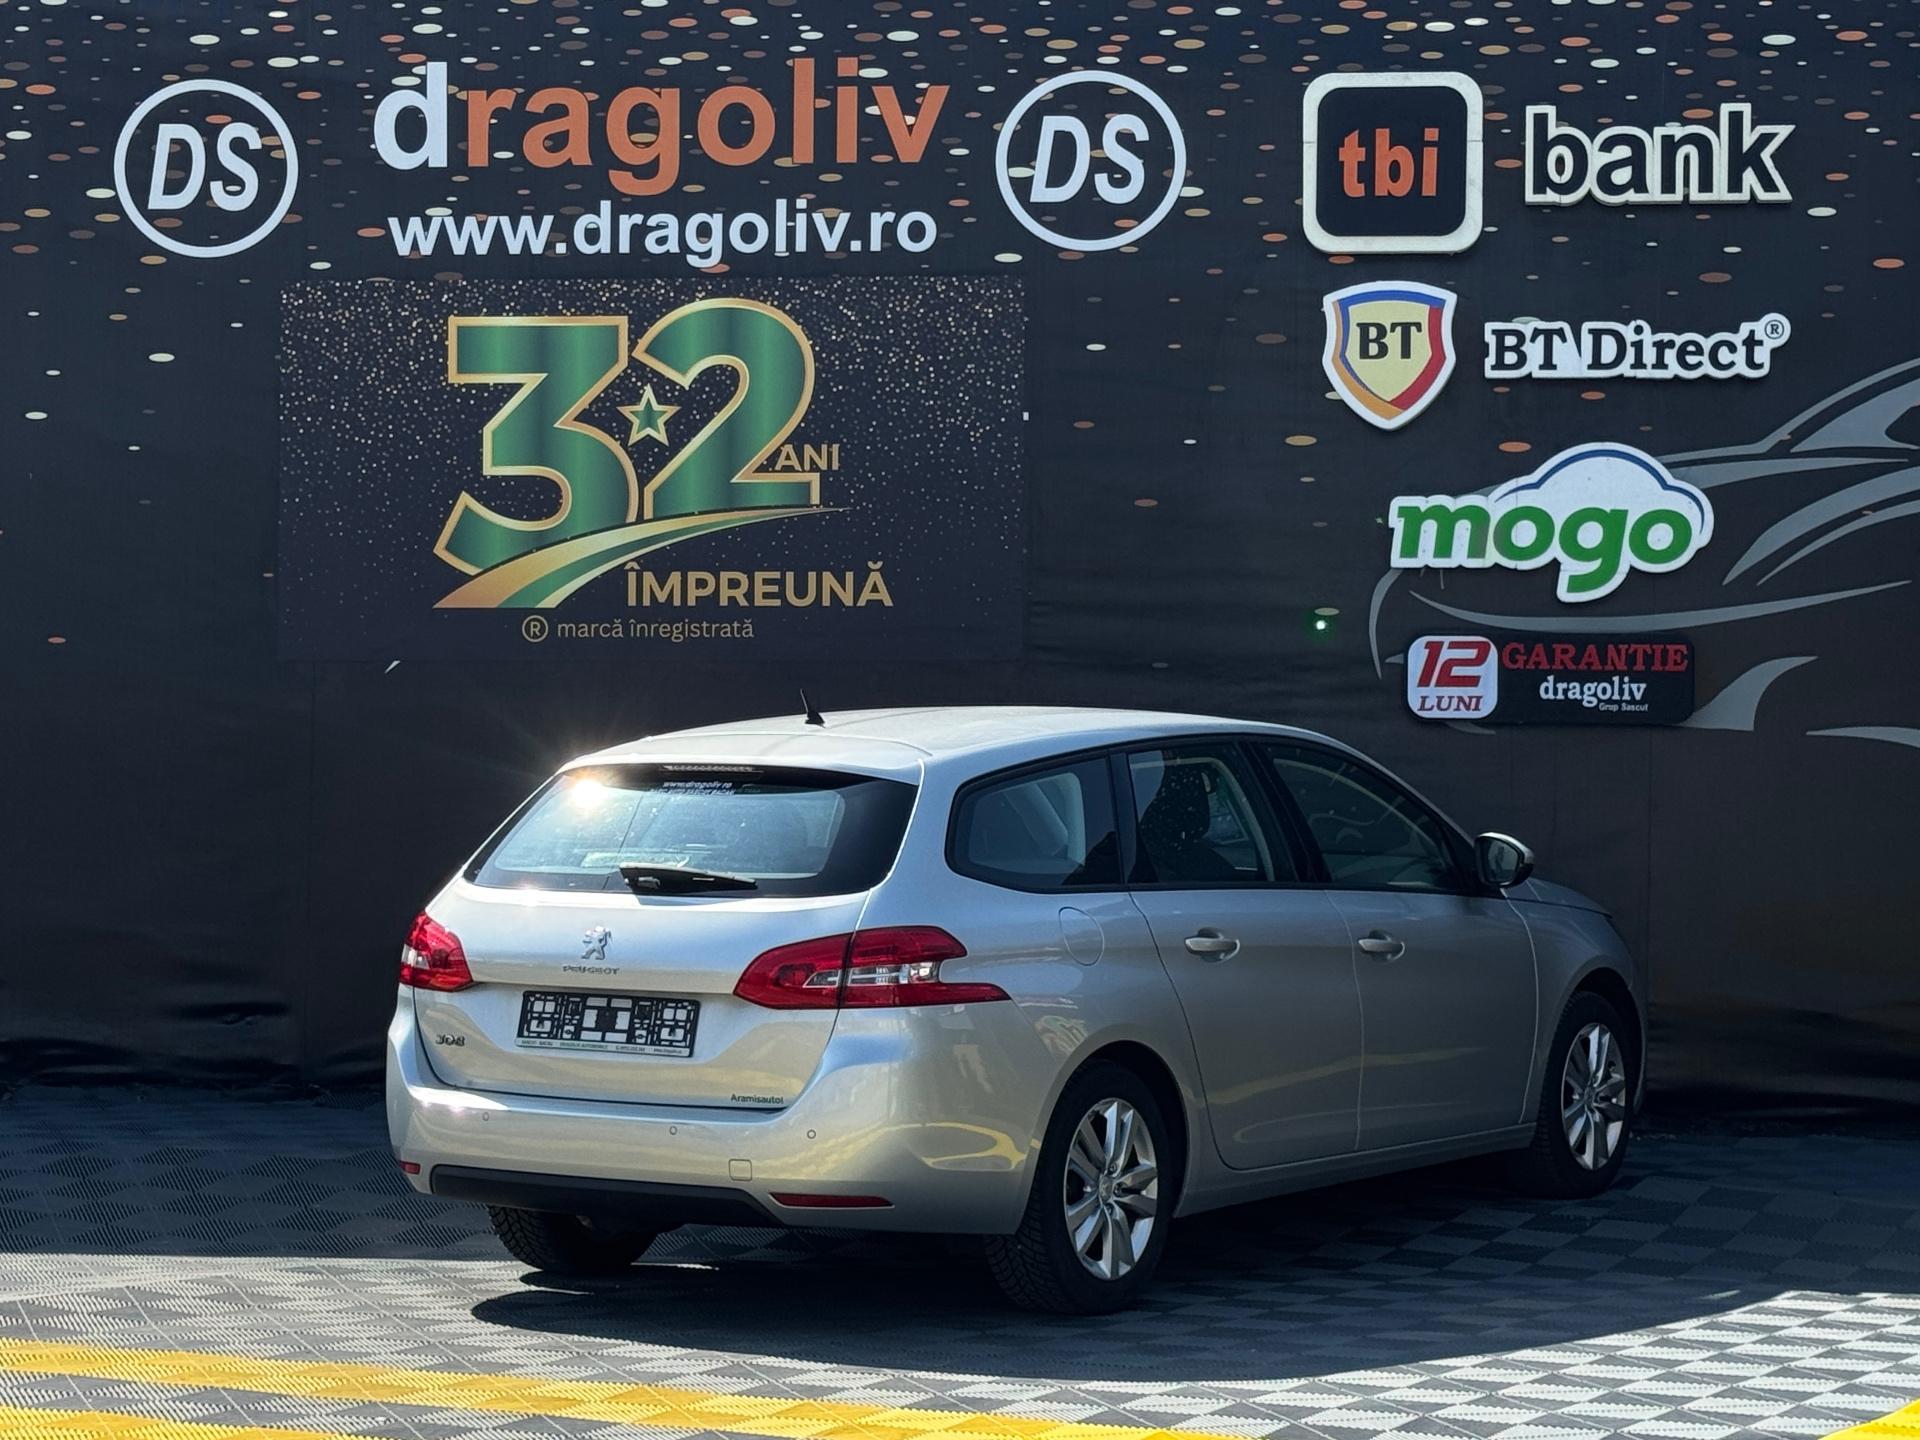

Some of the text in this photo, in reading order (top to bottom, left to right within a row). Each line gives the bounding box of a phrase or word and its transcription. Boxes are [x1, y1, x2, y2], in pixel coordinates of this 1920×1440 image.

[373, 57, 949, 196] dragoliv
[146, 121, 264, 212] DS
[1031, 113, 1150, 205] DS
[1338, 127, 1440, 198] tbi
[1525, 103, 1795, 205] bank
[387, 199, 938, 269] www.dragoliv.ro
[1357, 320, 1422, 360] BT
[1490, 326, 1568, 371] BT
[433, 297, 816, 577] 32
[774, 443, 841, 471] ANI
[1395, 501, 1694, 595] mogo
[624, 560, 894, 608] ÎMPREUNĂ
[557, 618, 624, 638] marcă
[629, 618, 755, 643] înregistrată
[1416, 640, 1492, 688] 12
[1501, 642, 1689, 672] GARANTIE
[1416, 695, 1482, 712] LUNI
[1539, 675, 1648, 708] dragoliv
[562, 965, 620, 975] PEUGEOT
[435, 1033, 465, 1047] 308
